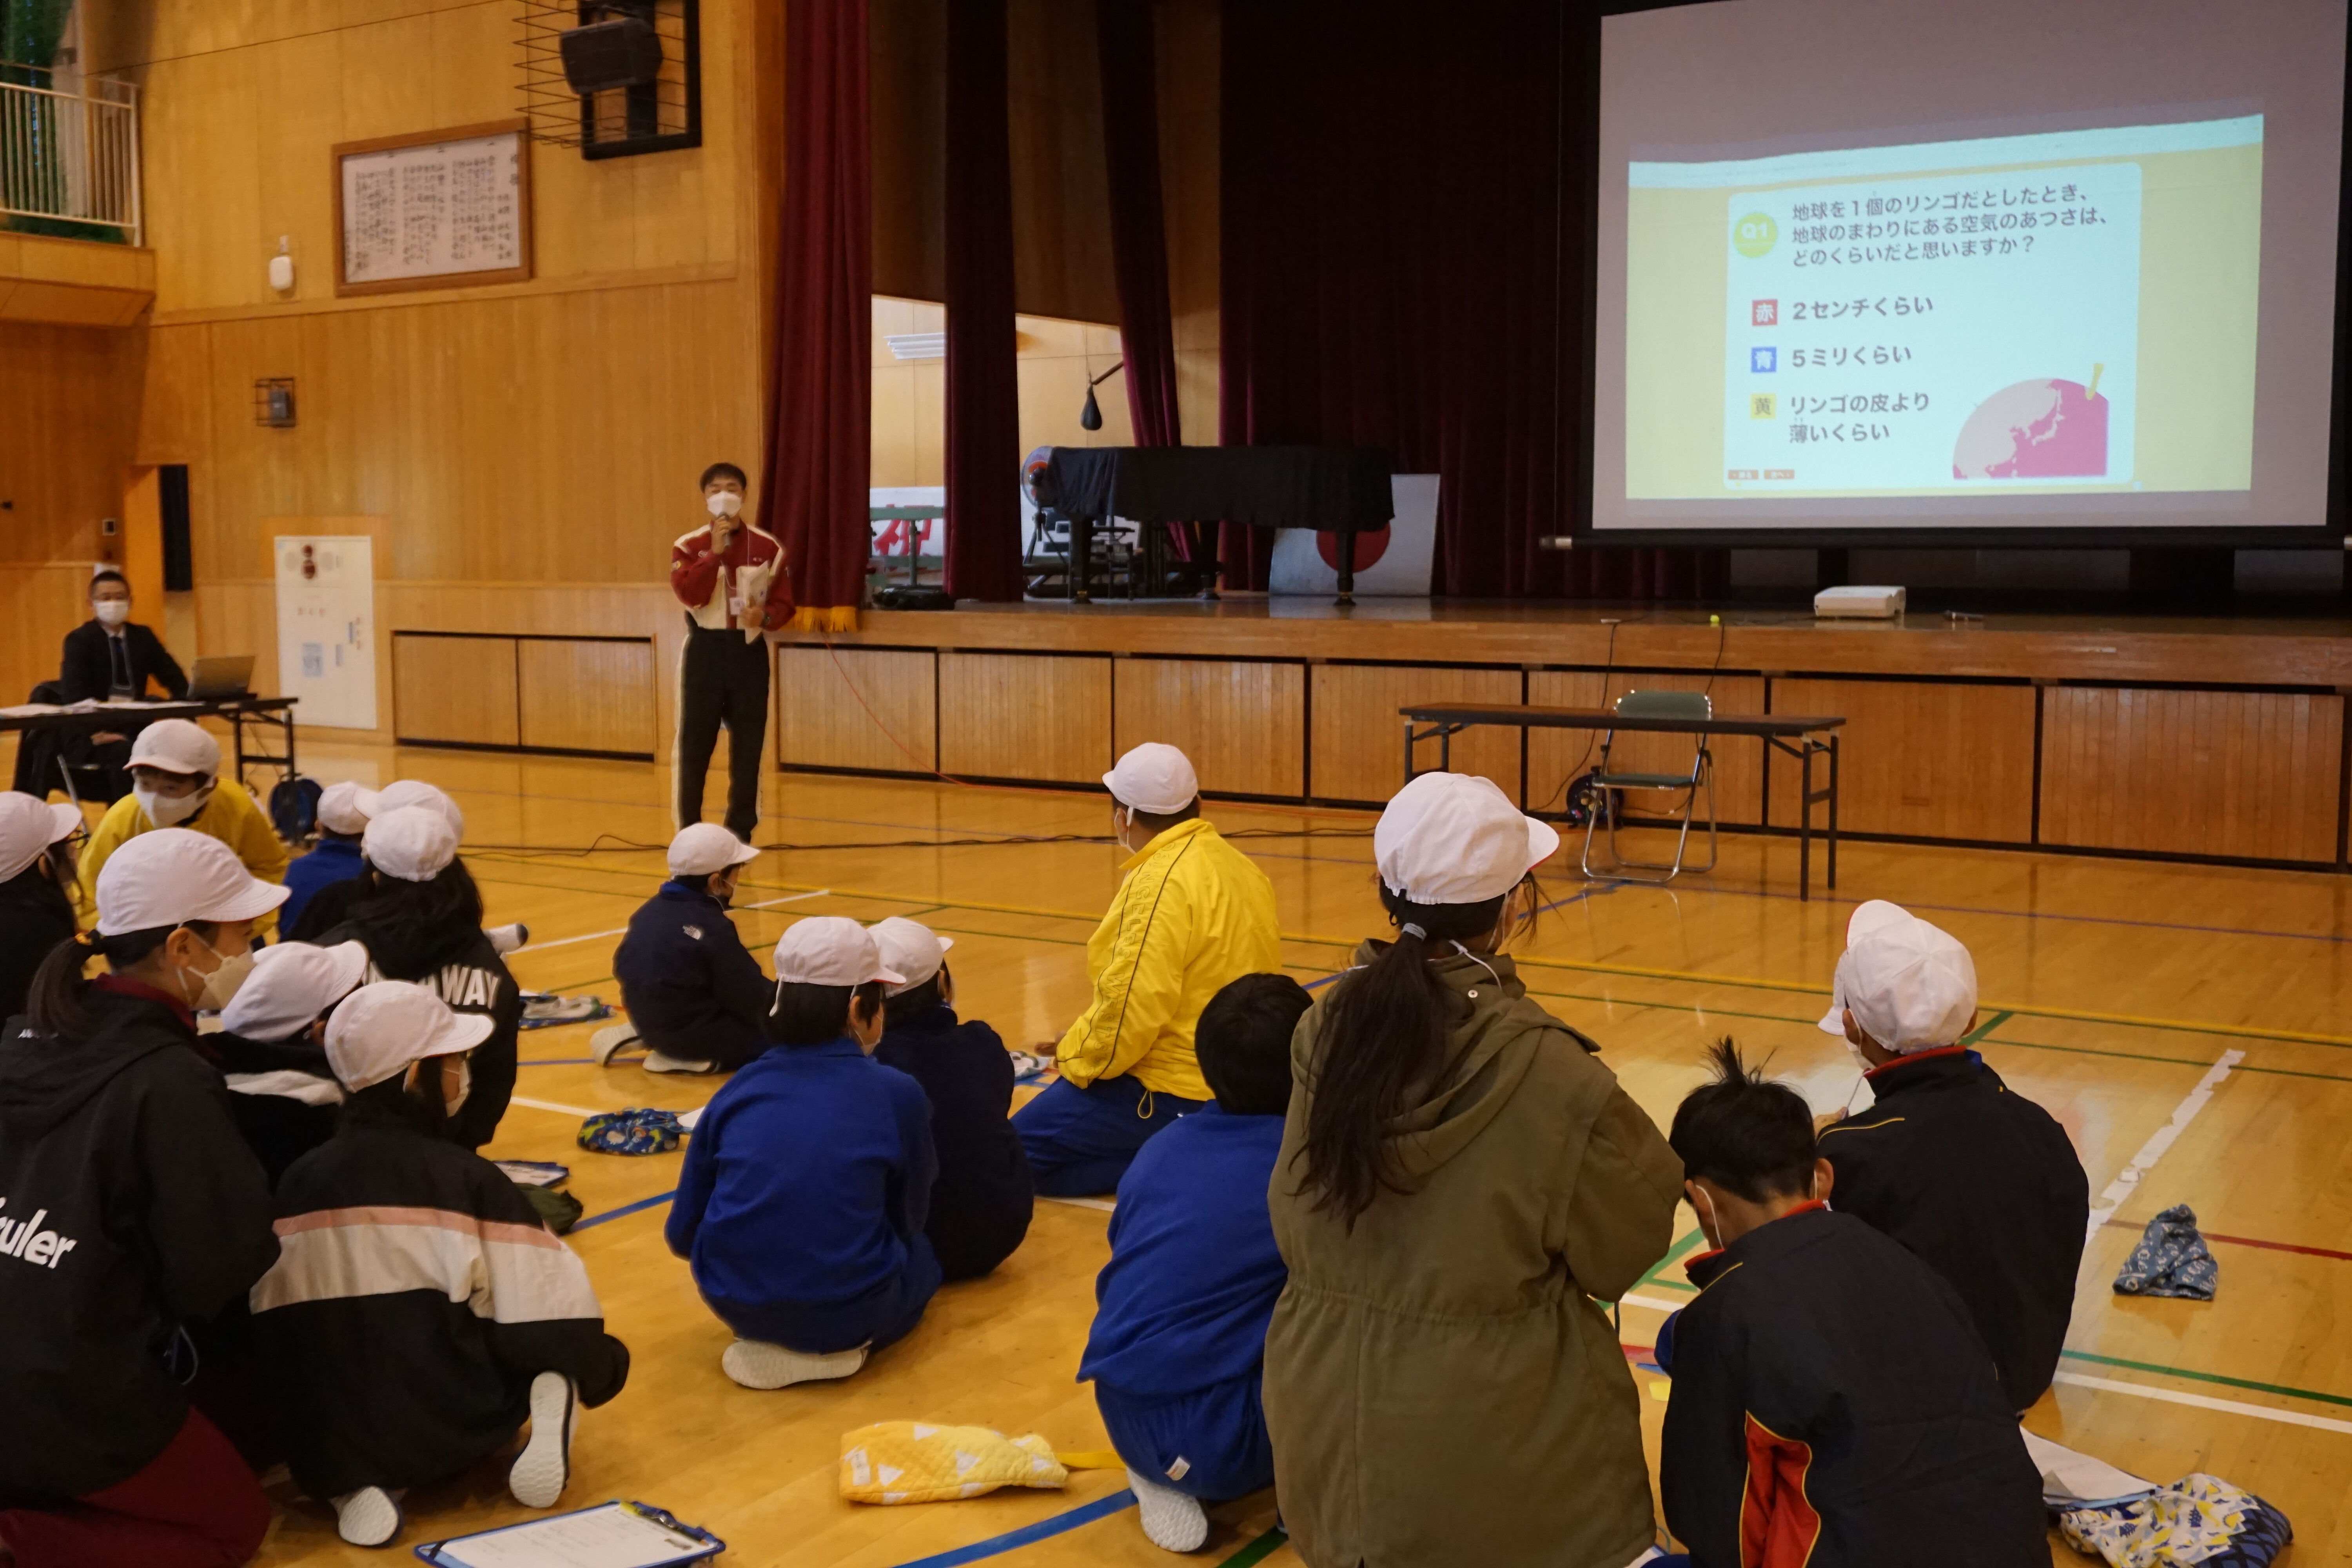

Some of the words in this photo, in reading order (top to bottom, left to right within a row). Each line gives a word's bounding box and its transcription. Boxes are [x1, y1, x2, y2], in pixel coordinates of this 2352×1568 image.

[1792, 184, 2086, 221] 地球を1個のリンゴだとしたとき、
[1741, 222, 1767, 239] Q1
[1792, 207, 2106, 244] 地球のまわりにある空気のあつさは、
[1793, 235, 2034, 267] どのくらいだと思いますか？
[1755, 303, 1774, 323] 赤
[1792, 296, 1933, 320] 2センチくらい
[1792, 345, 1912, 367] 5ミリくらい
[1754, 397, 1771, 416] 黄
[1791, 392, 1929, 415] リンゴの皮より
[1789, 423, 1890, 443] 薄いくらい
